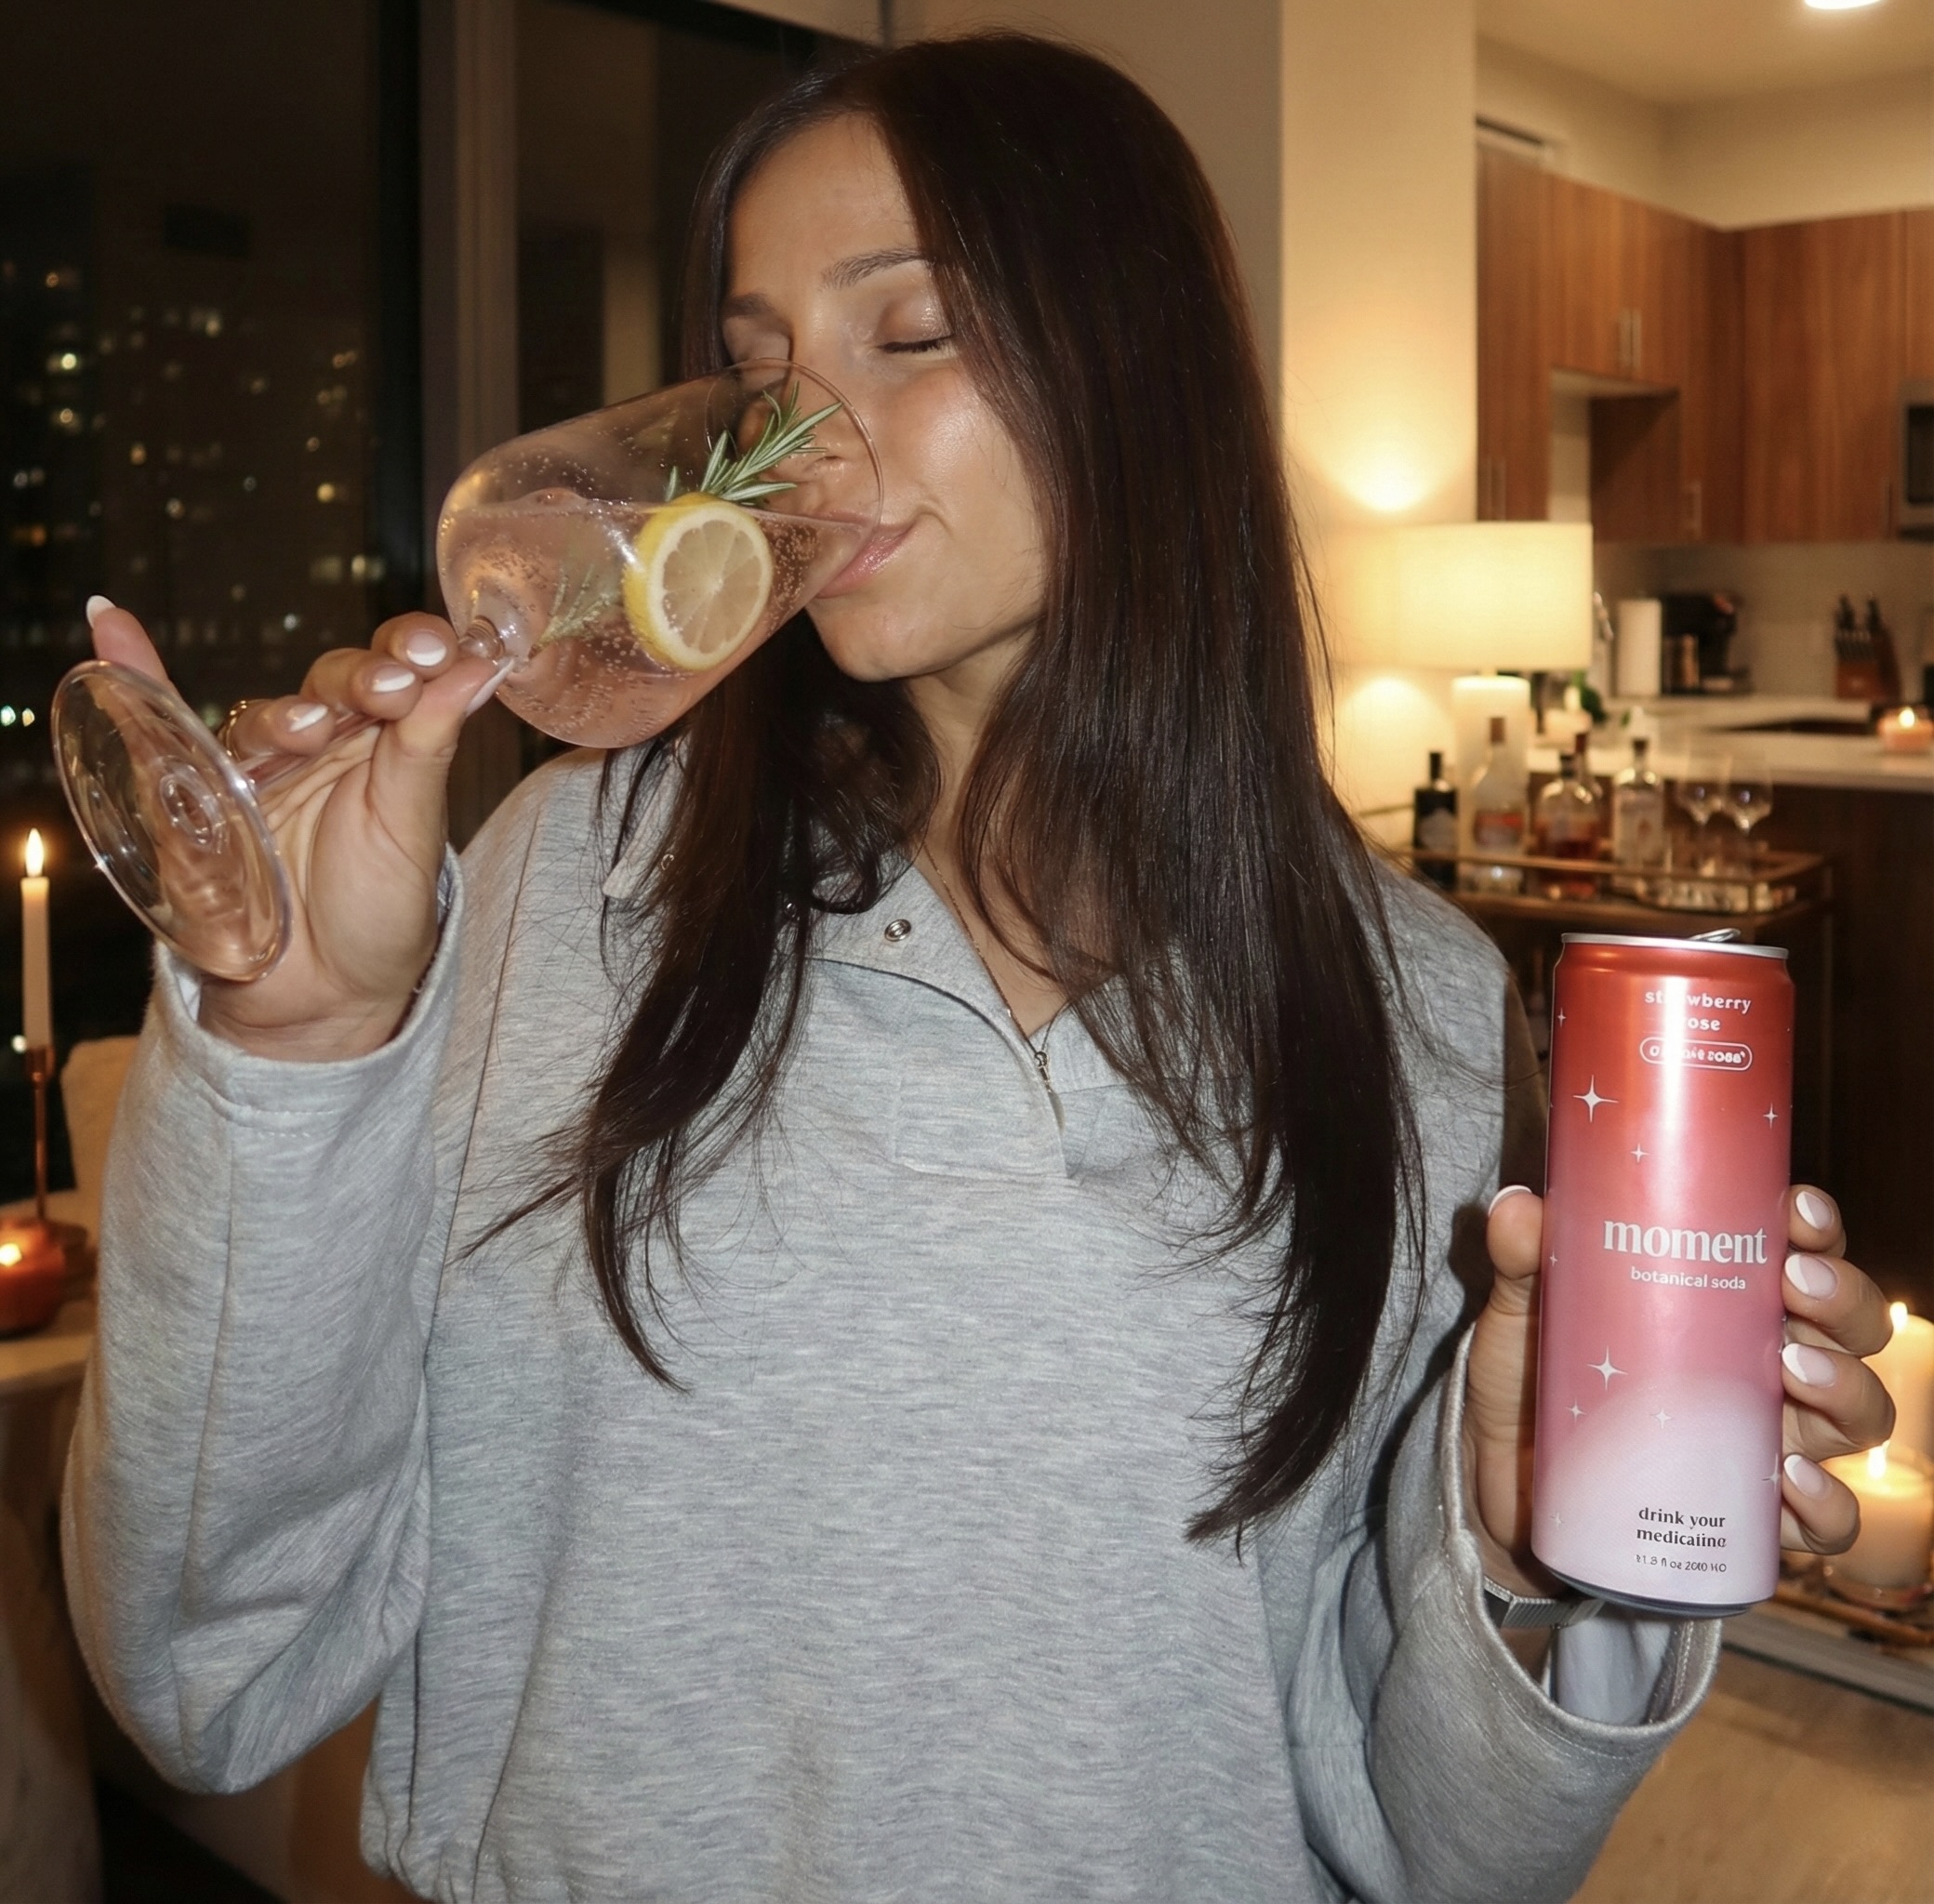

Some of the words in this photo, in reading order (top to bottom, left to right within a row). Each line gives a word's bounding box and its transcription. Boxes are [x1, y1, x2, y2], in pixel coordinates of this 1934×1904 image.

[1644, 989, 1752, 1015] stwberry
[1680, 1017, 1721, 1032] ose
[1603, 1220, 1768, 1264] moment
[1630, 1266, 1708, 1288] botanical
[1711, 1273, 1746, 1289] soda
[1638, 1507, 1684, 1525] drink
[1689, 1515, 1726, 1529] your
